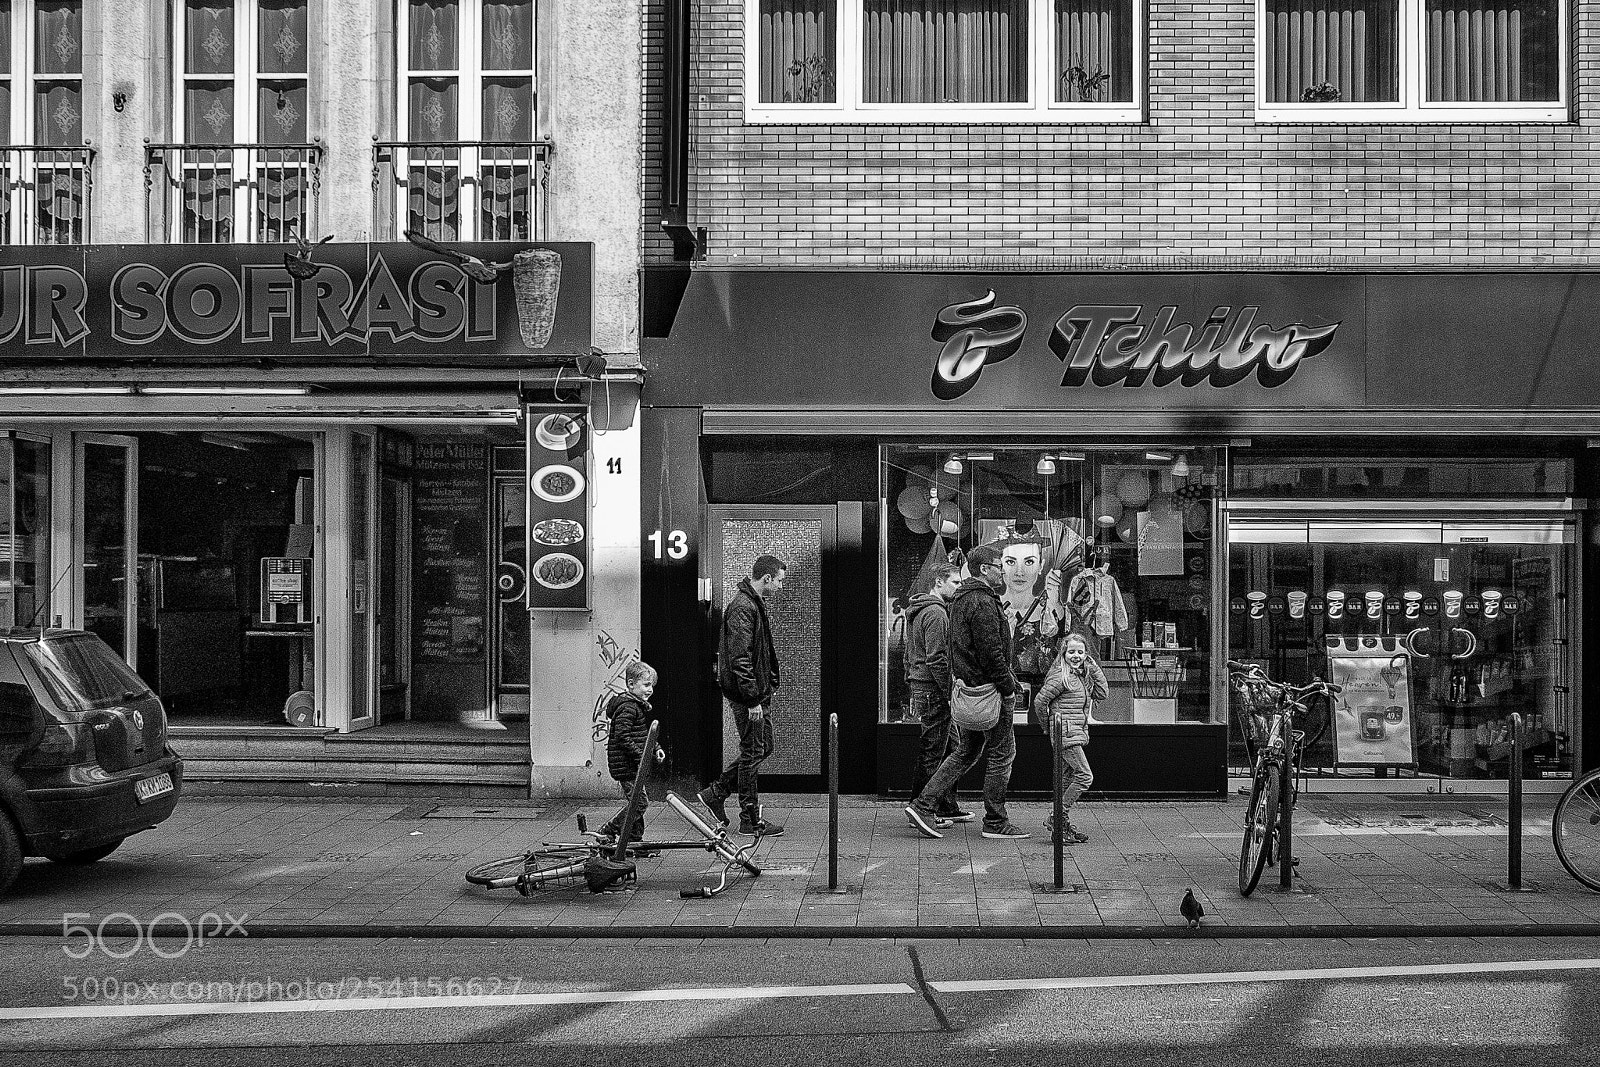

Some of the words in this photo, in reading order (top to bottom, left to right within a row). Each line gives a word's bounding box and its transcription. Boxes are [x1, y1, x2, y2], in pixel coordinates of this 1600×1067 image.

[110, 250, 498, 346] SOFRASI
[1047, 305, 1343, 388] Tchibo
[606, 457, 622, 474] 11
[648, 530, 688, 559] 13
